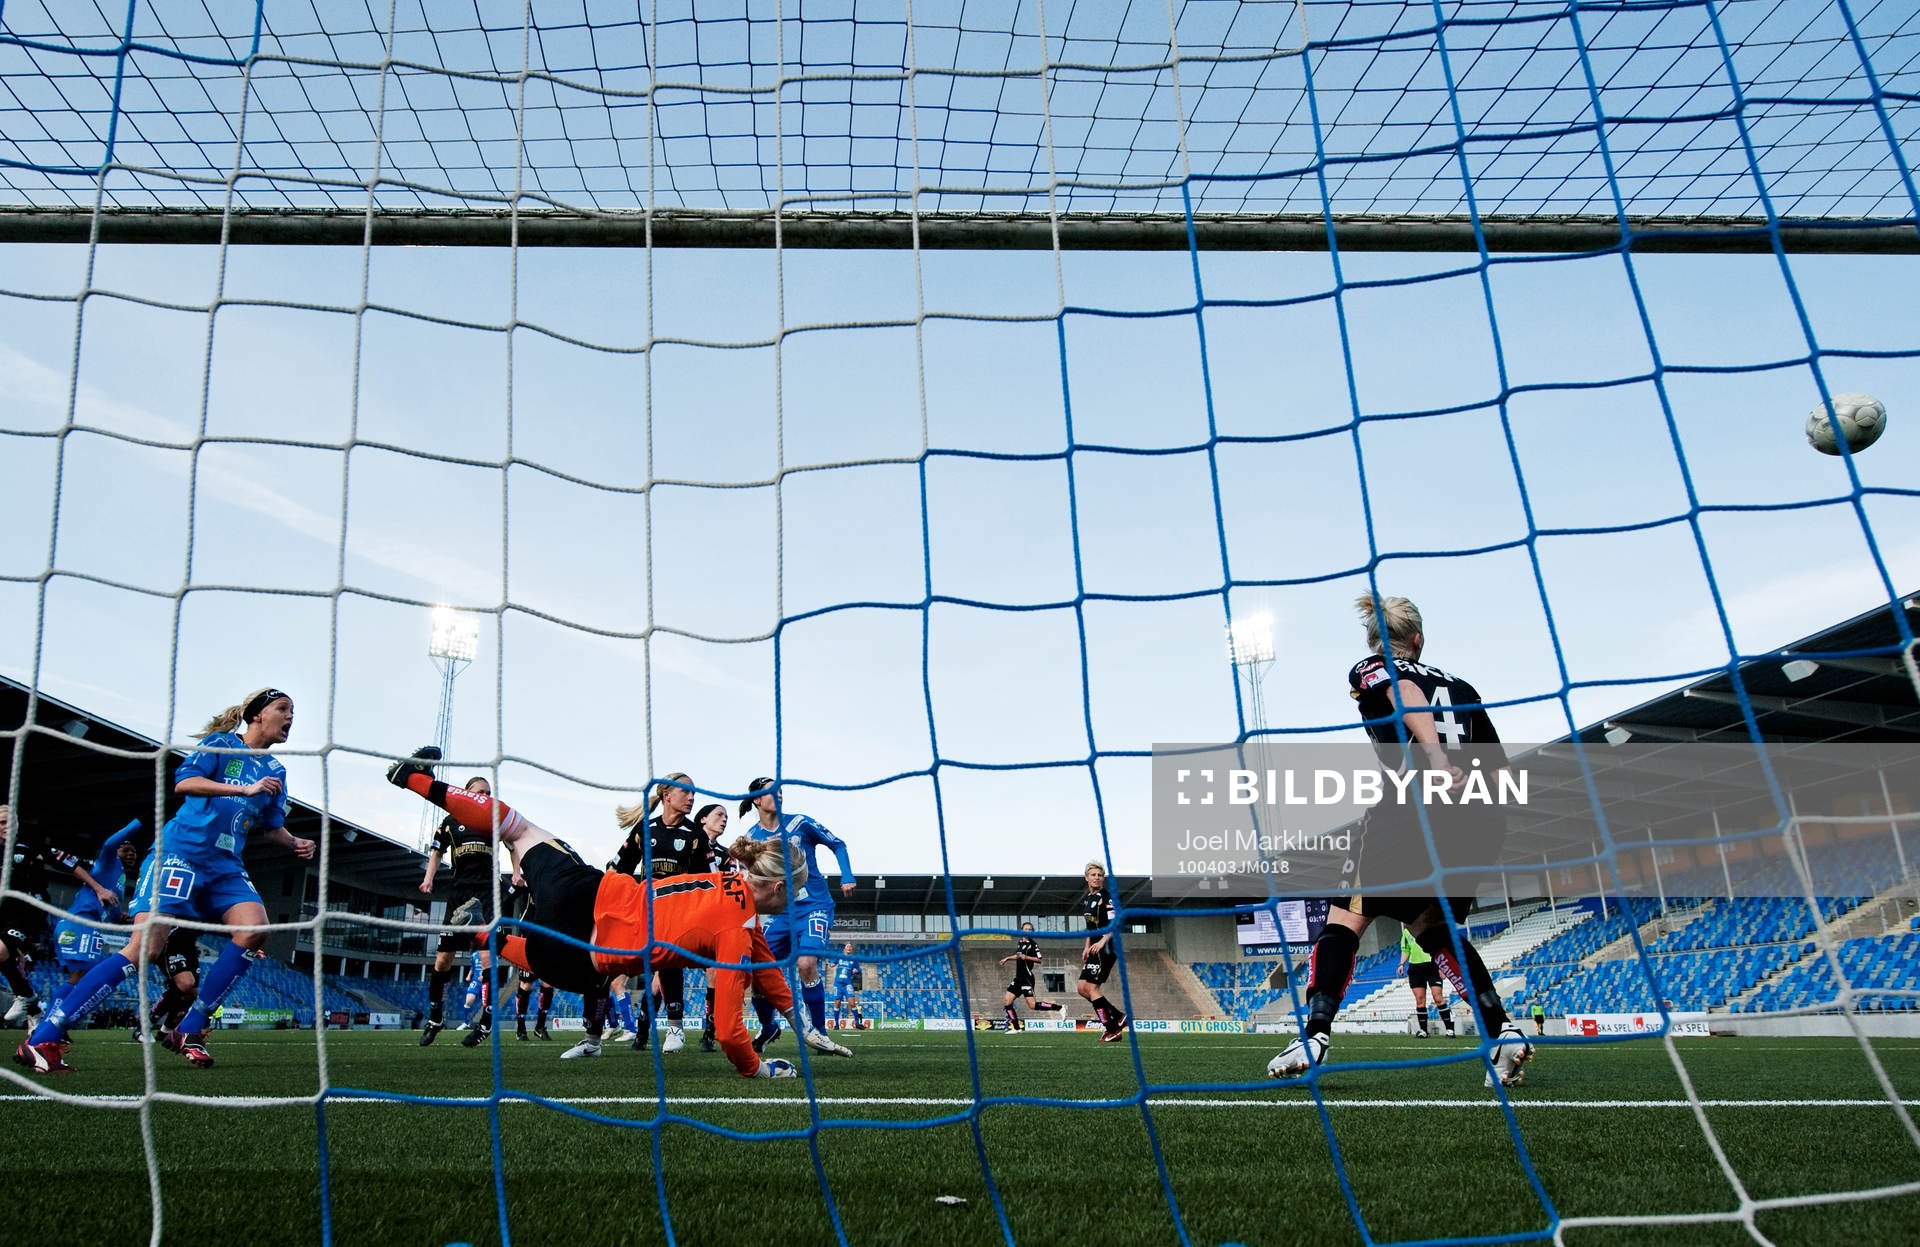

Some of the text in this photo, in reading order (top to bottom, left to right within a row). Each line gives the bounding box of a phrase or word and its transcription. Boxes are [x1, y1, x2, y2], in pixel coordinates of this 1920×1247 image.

[1430, 686, 1465, 750] 4
[833, 918, 871, 927] stadium
[1027, 1021, 1074, 1029] EAB EAB
[1180, 1021, 1242, 1032] CITY GROSS
[1613, 1023, 1632, 1032] SPEL
[1686, 1023, 1708, 1032] SPEL
